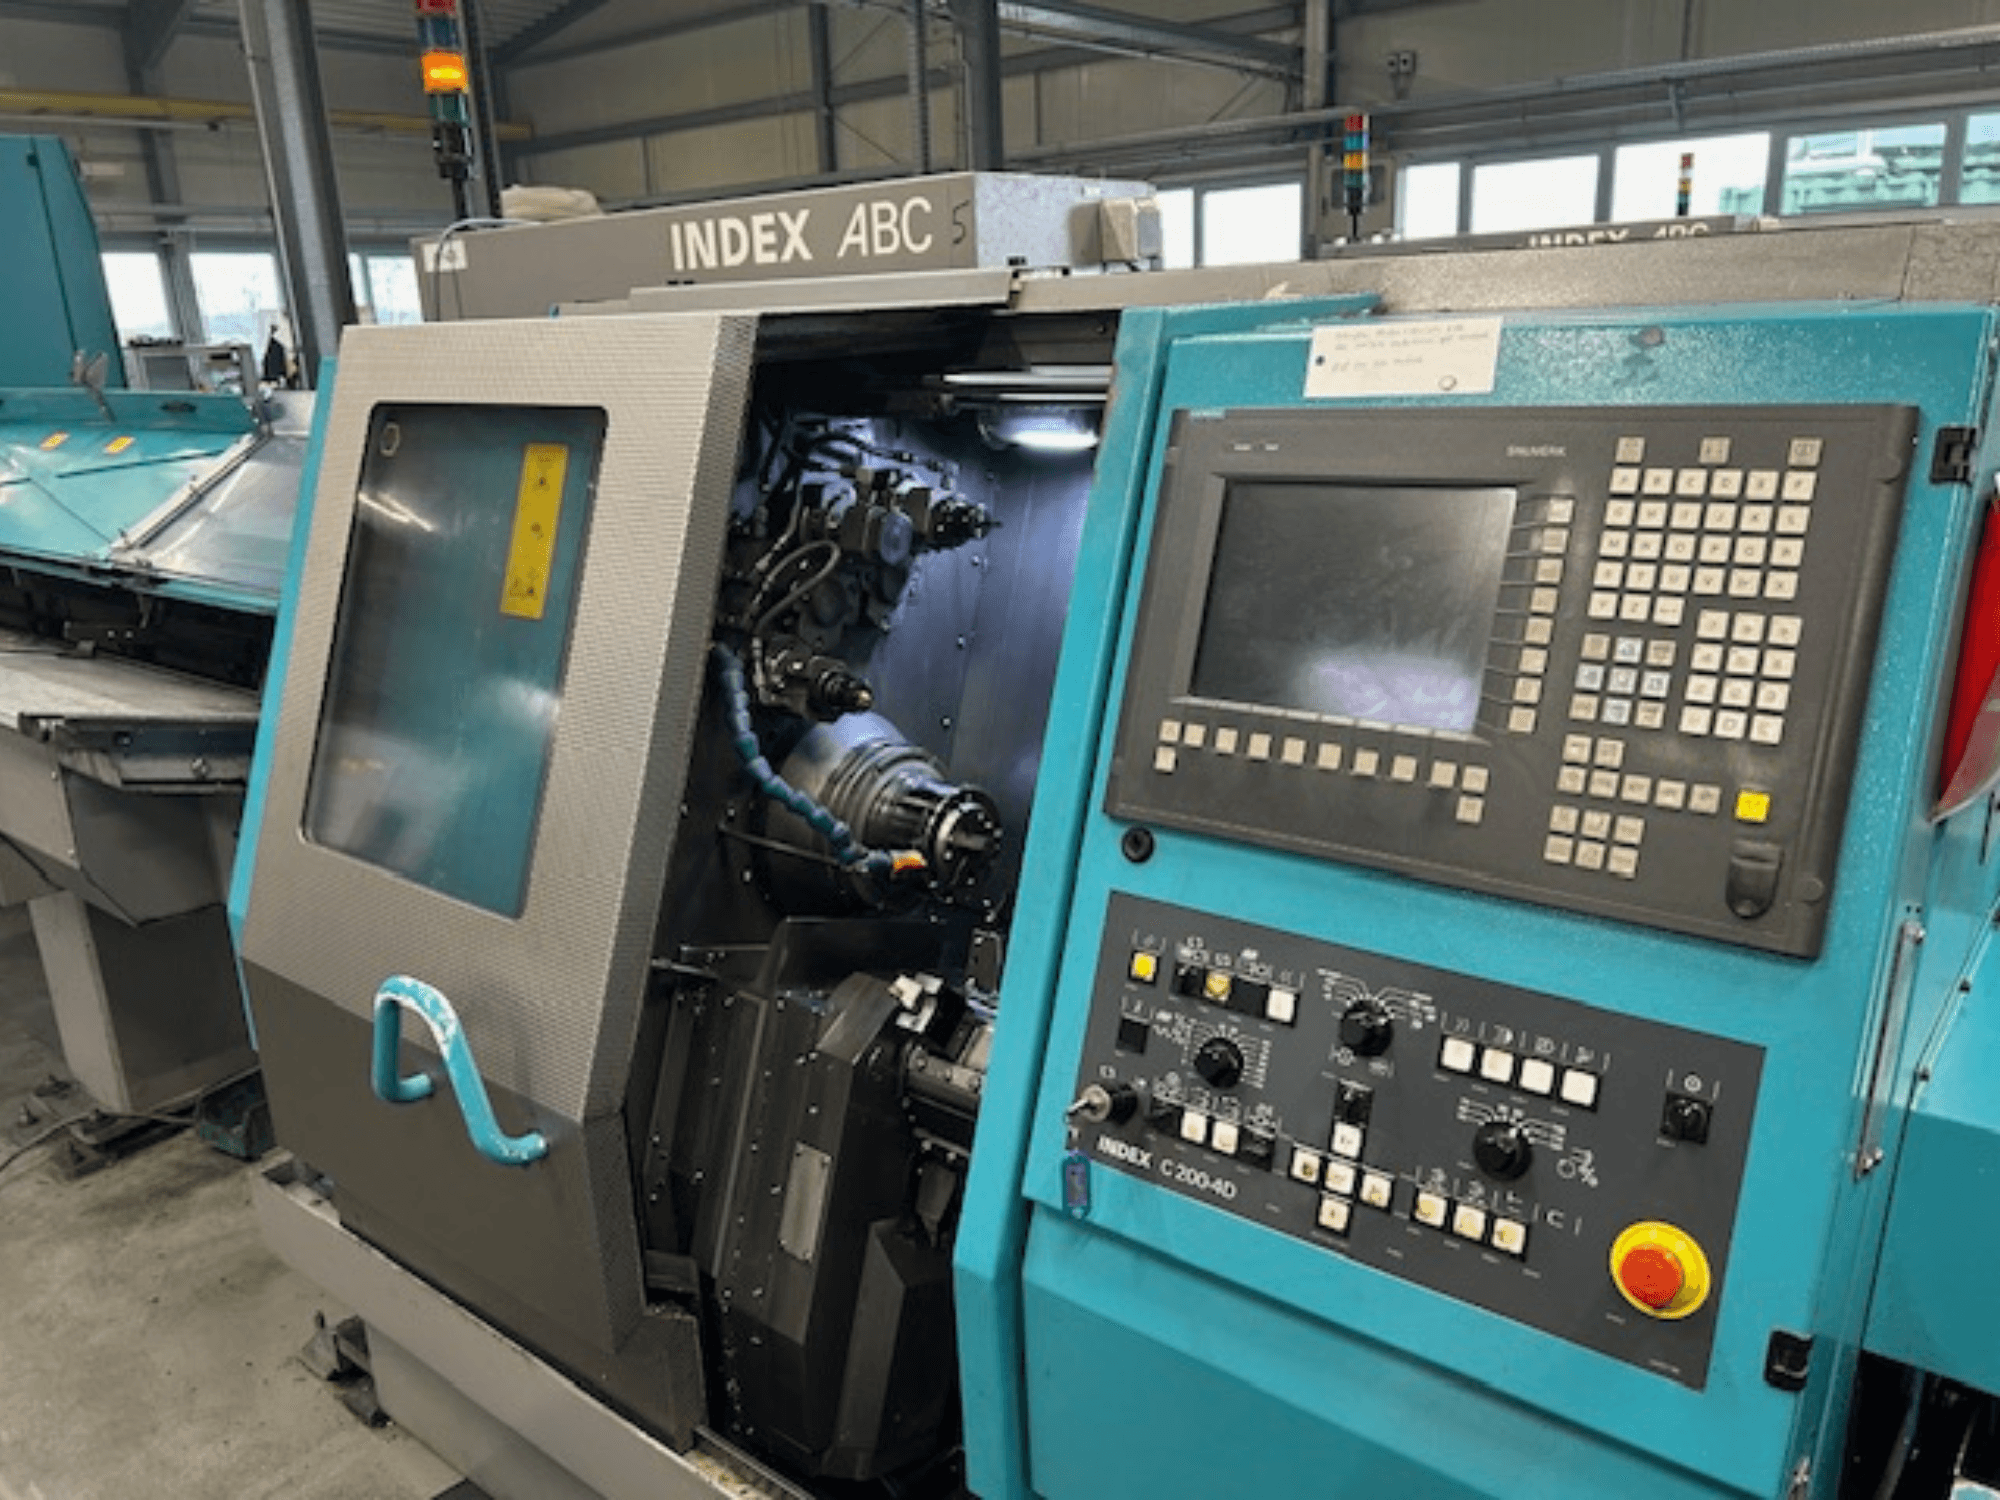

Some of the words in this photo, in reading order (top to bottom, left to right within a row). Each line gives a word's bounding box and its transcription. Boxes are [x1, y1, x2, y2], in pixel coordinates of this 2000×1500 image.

[670, 208, 813, 272] INDEX
[836, 196, 933, 259] ABC
[1097, 1134, 1153, 1170] INDEX
